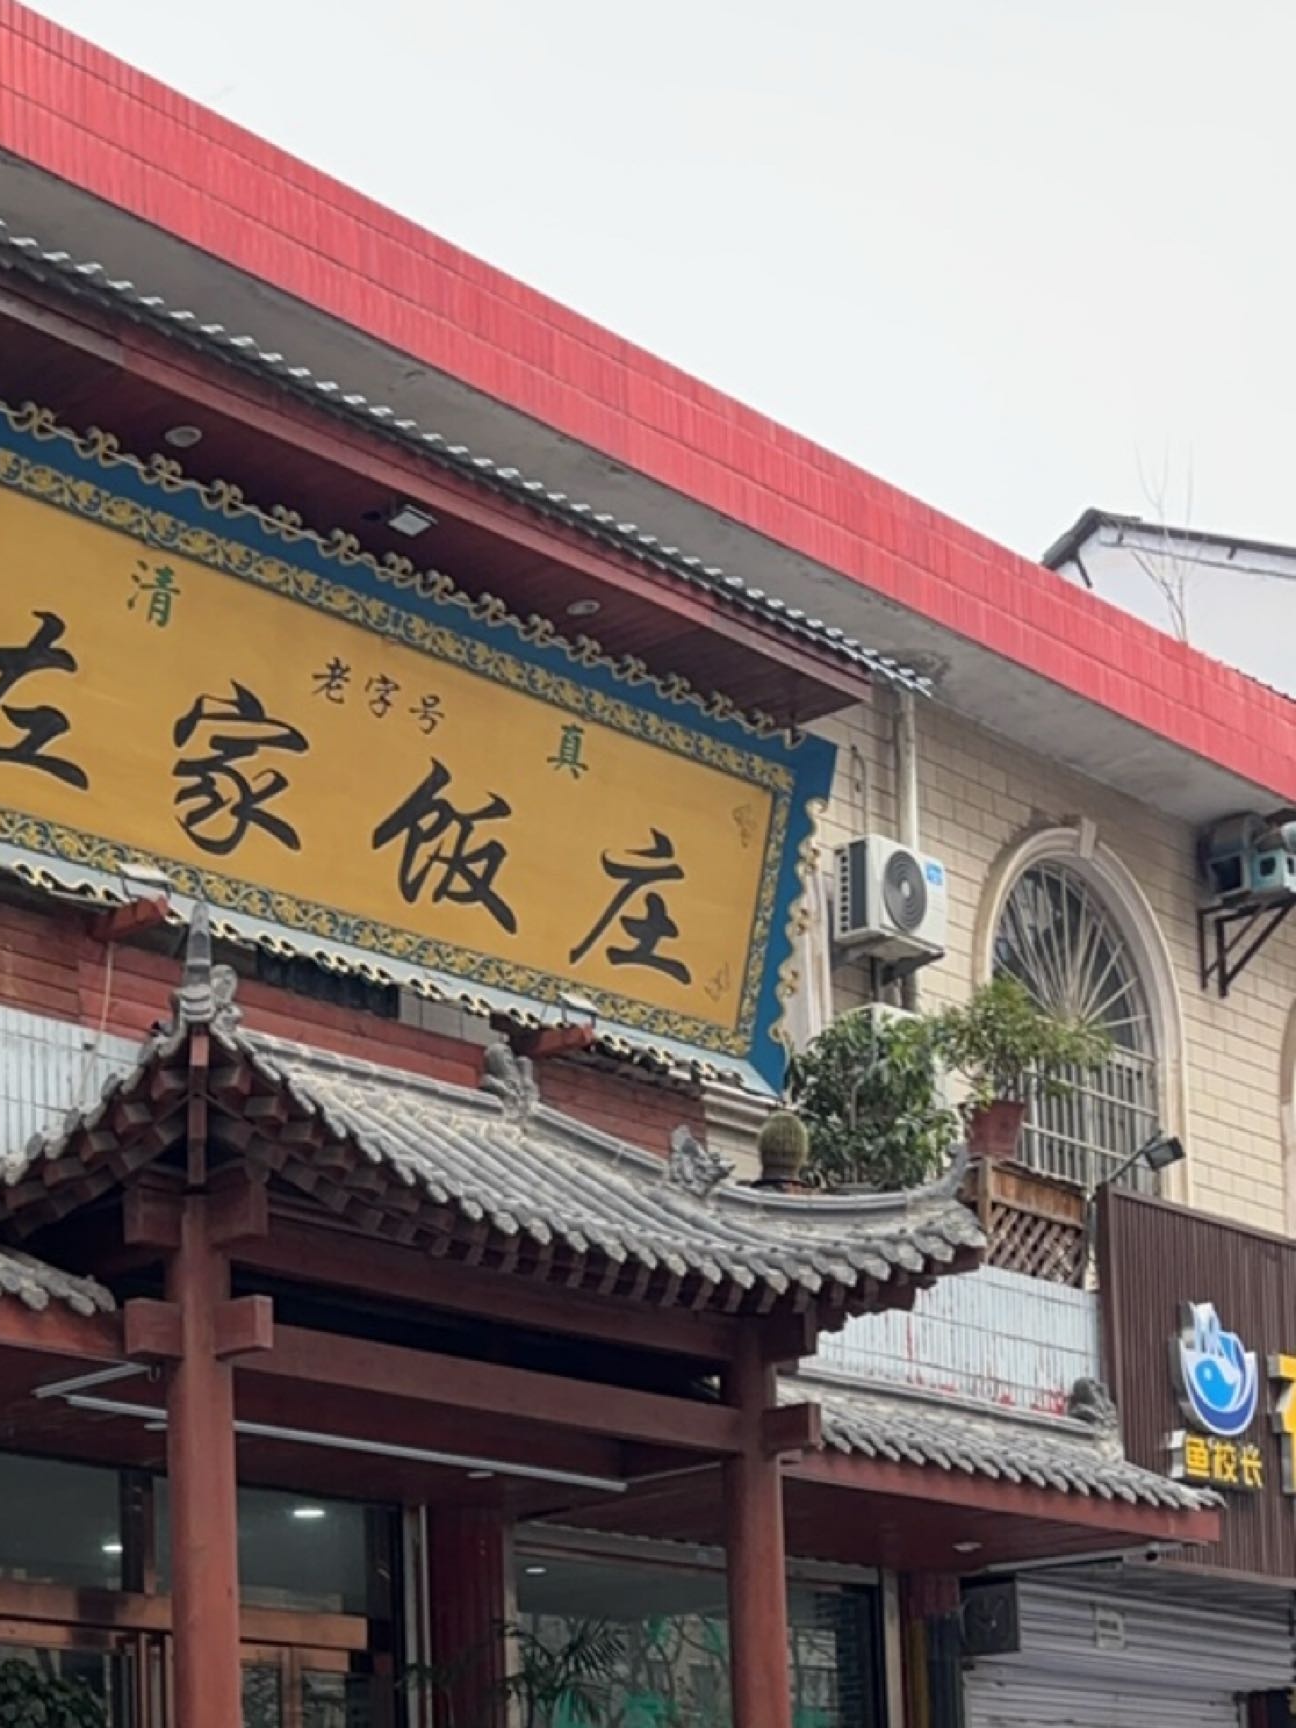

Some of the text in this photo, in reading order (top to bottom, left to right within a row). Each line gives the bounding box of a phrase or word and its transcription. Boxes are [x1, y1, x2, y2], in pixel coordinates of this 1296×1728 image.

[125, 558, 590, 782] 清 真
[310, 655, 447, 738] 老字号
